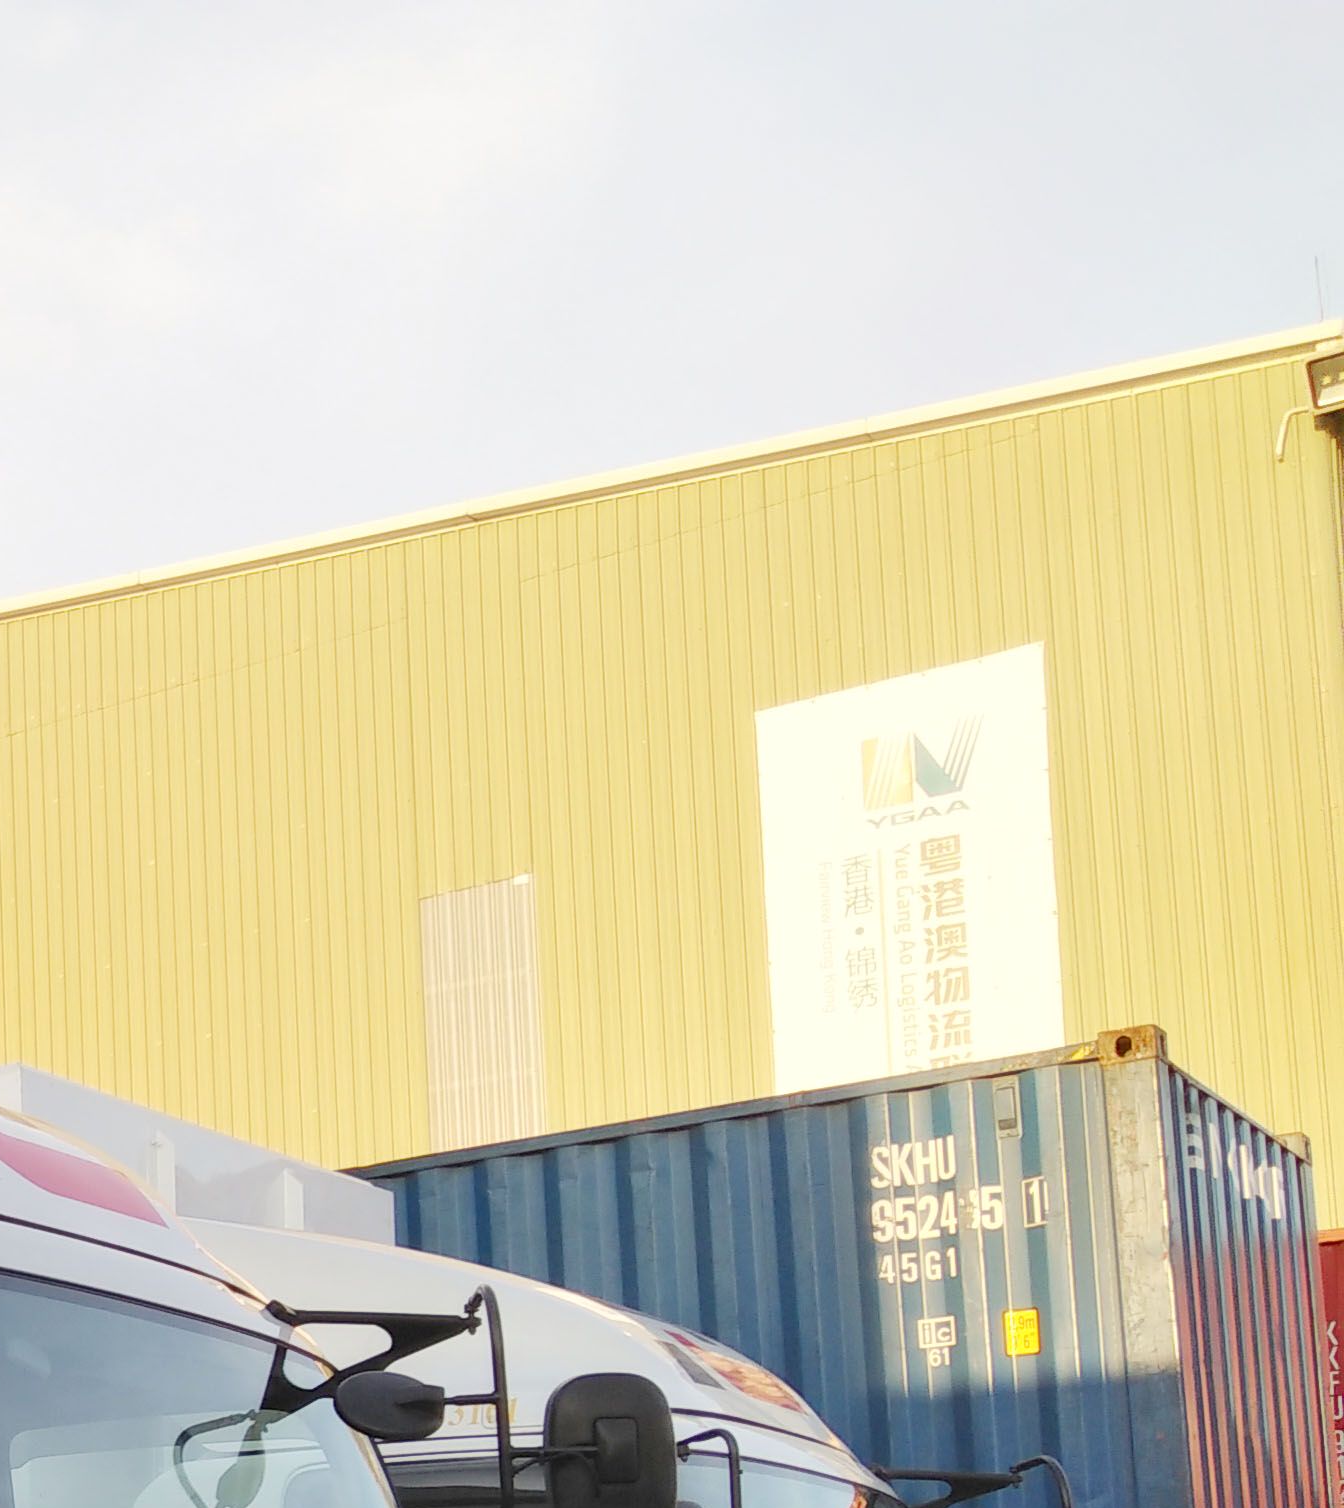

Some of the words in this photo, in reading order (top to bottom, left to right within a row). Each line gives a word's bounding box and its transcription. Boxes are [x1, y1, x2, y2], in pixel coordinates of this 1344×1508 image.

[866, 799, 970, 829] YGAA
[895, 842, 912, 879] Yue
[894, 885, 916, 935] Gang
[897, 972, 920, 1058] Logistics
[870, 1135, 957, 1189] SKHU
[878, 1247, 958, 1285] 45G1
